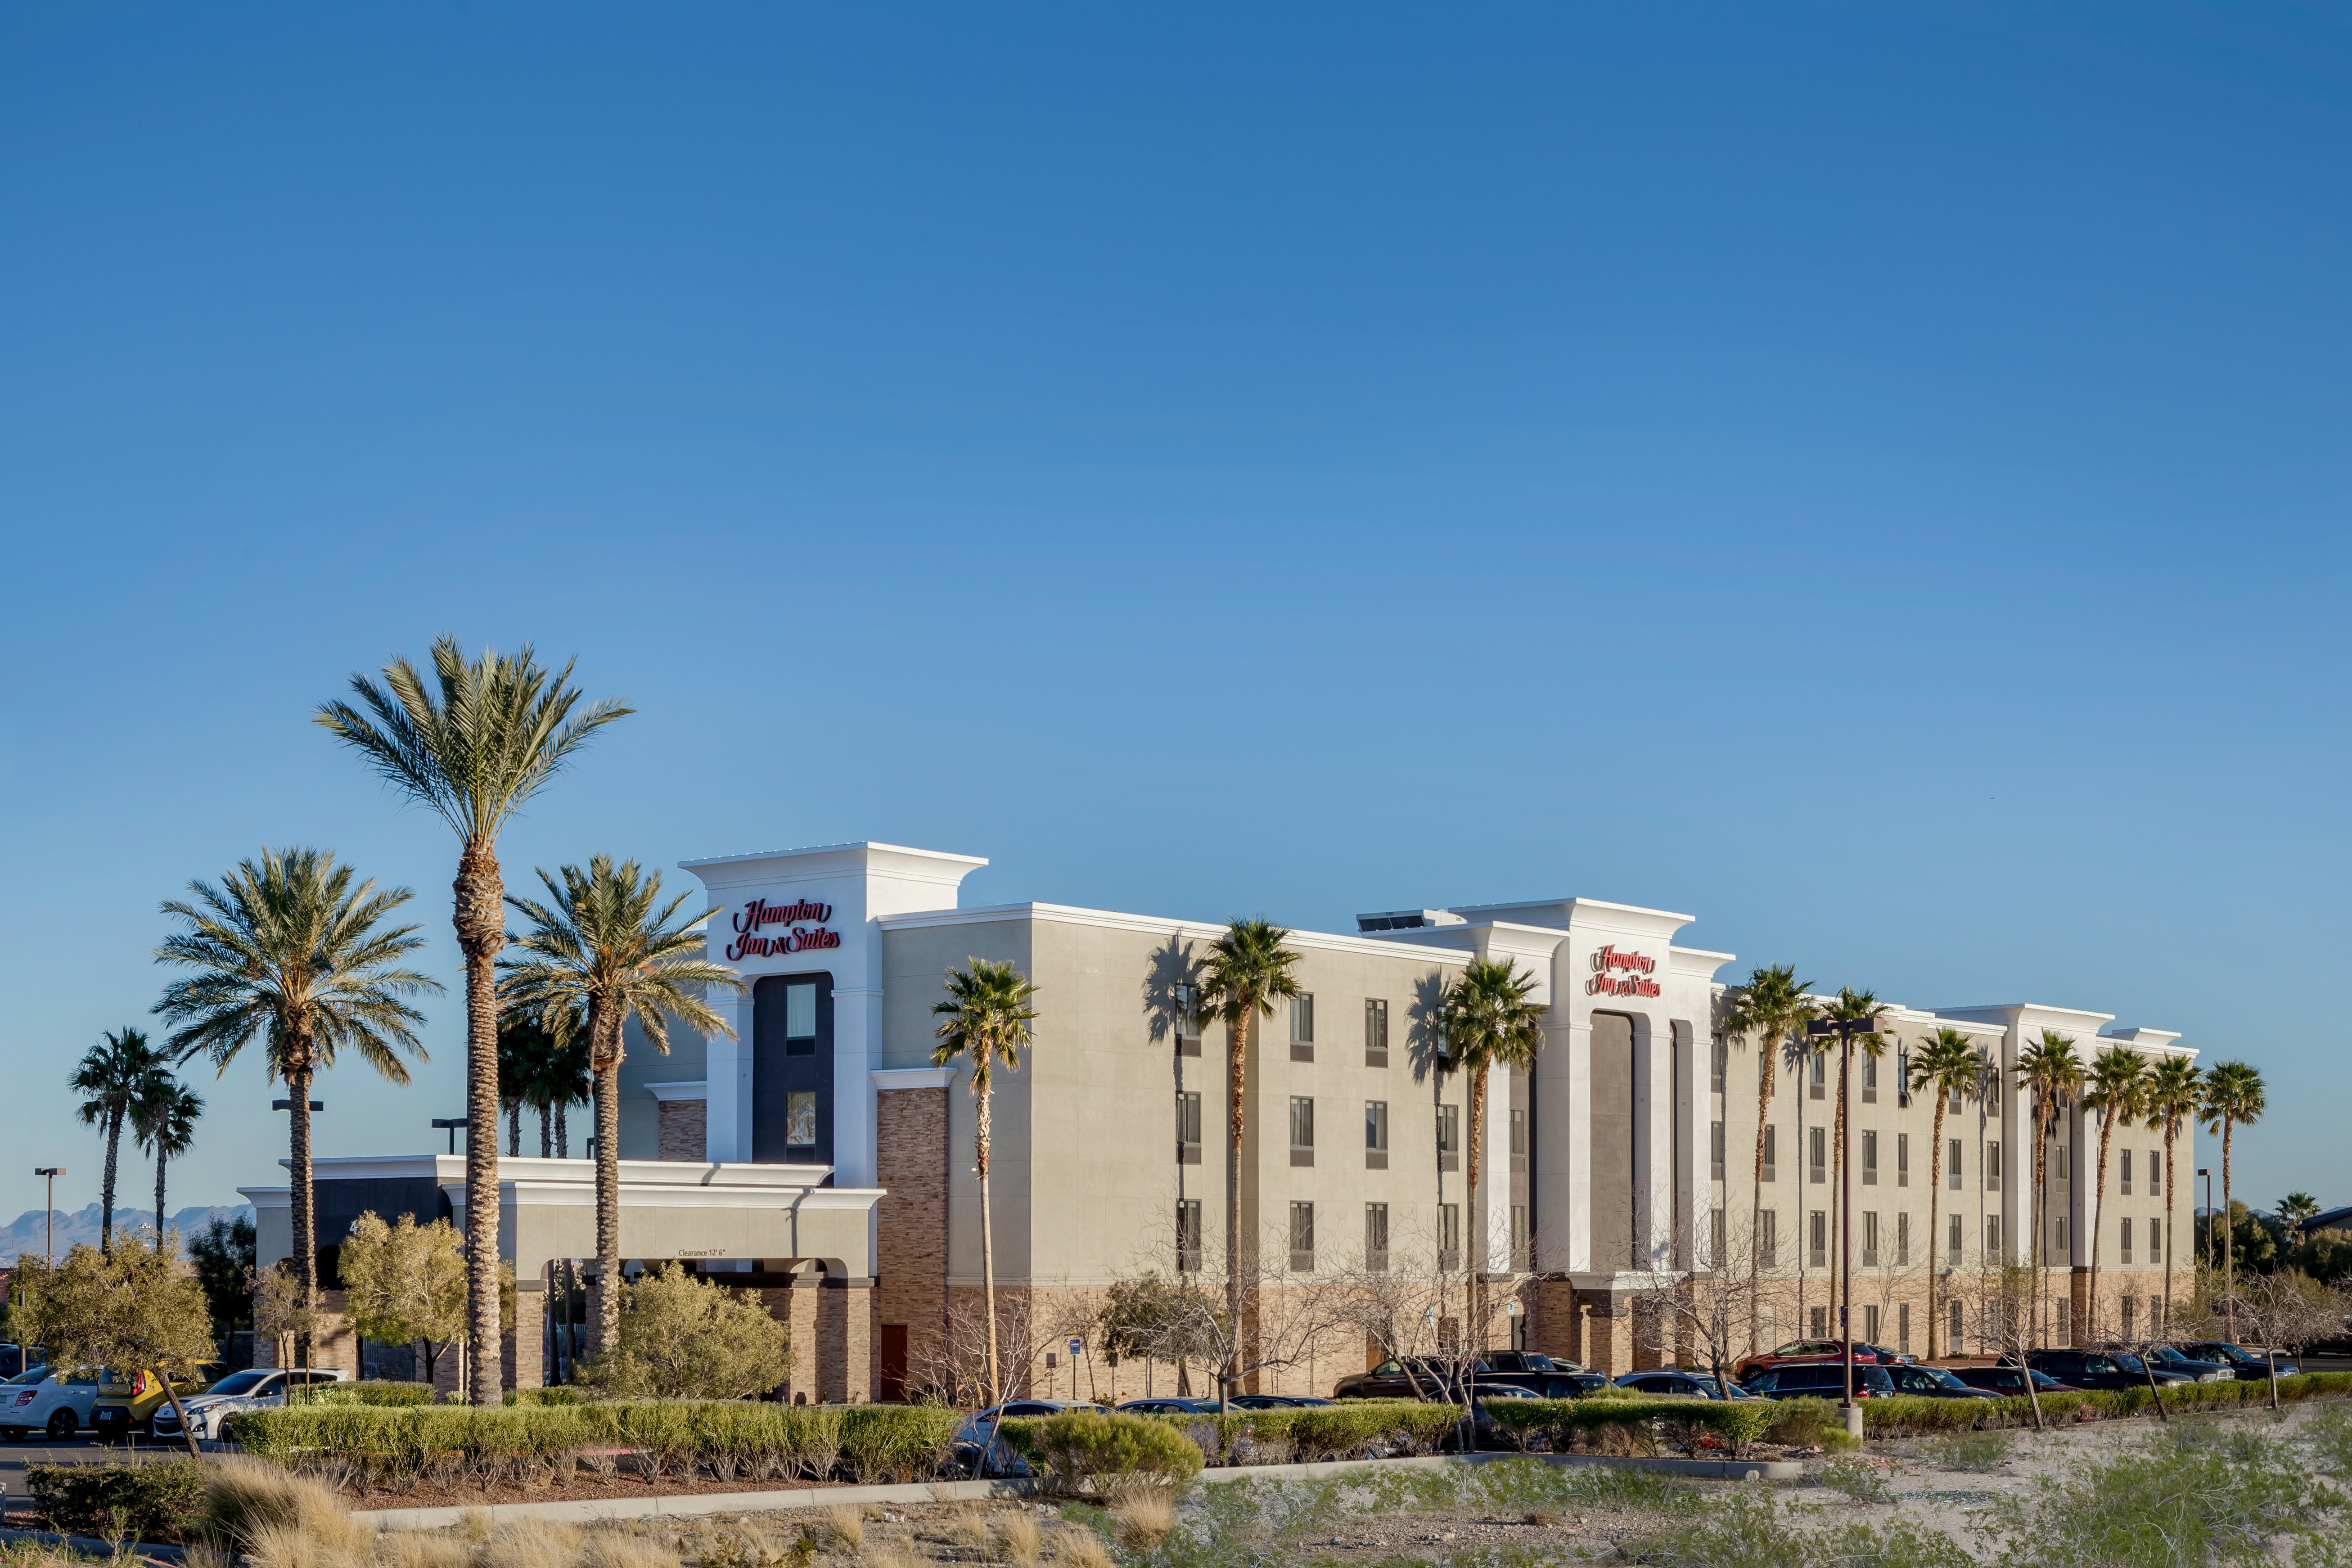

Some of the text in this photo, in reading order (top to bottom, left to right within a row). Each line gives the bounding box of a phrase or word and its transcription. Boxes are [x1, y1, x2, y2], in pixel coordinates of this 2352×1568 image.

[732, 898, 832, 933] Hampton
[725, 927, 840, 961] Inn & Suites
[1593, 944, 1656, 973] Hampton
[1589, 973, 1622, 995] Inn
[1628, 974, 1661, 997] Suites
